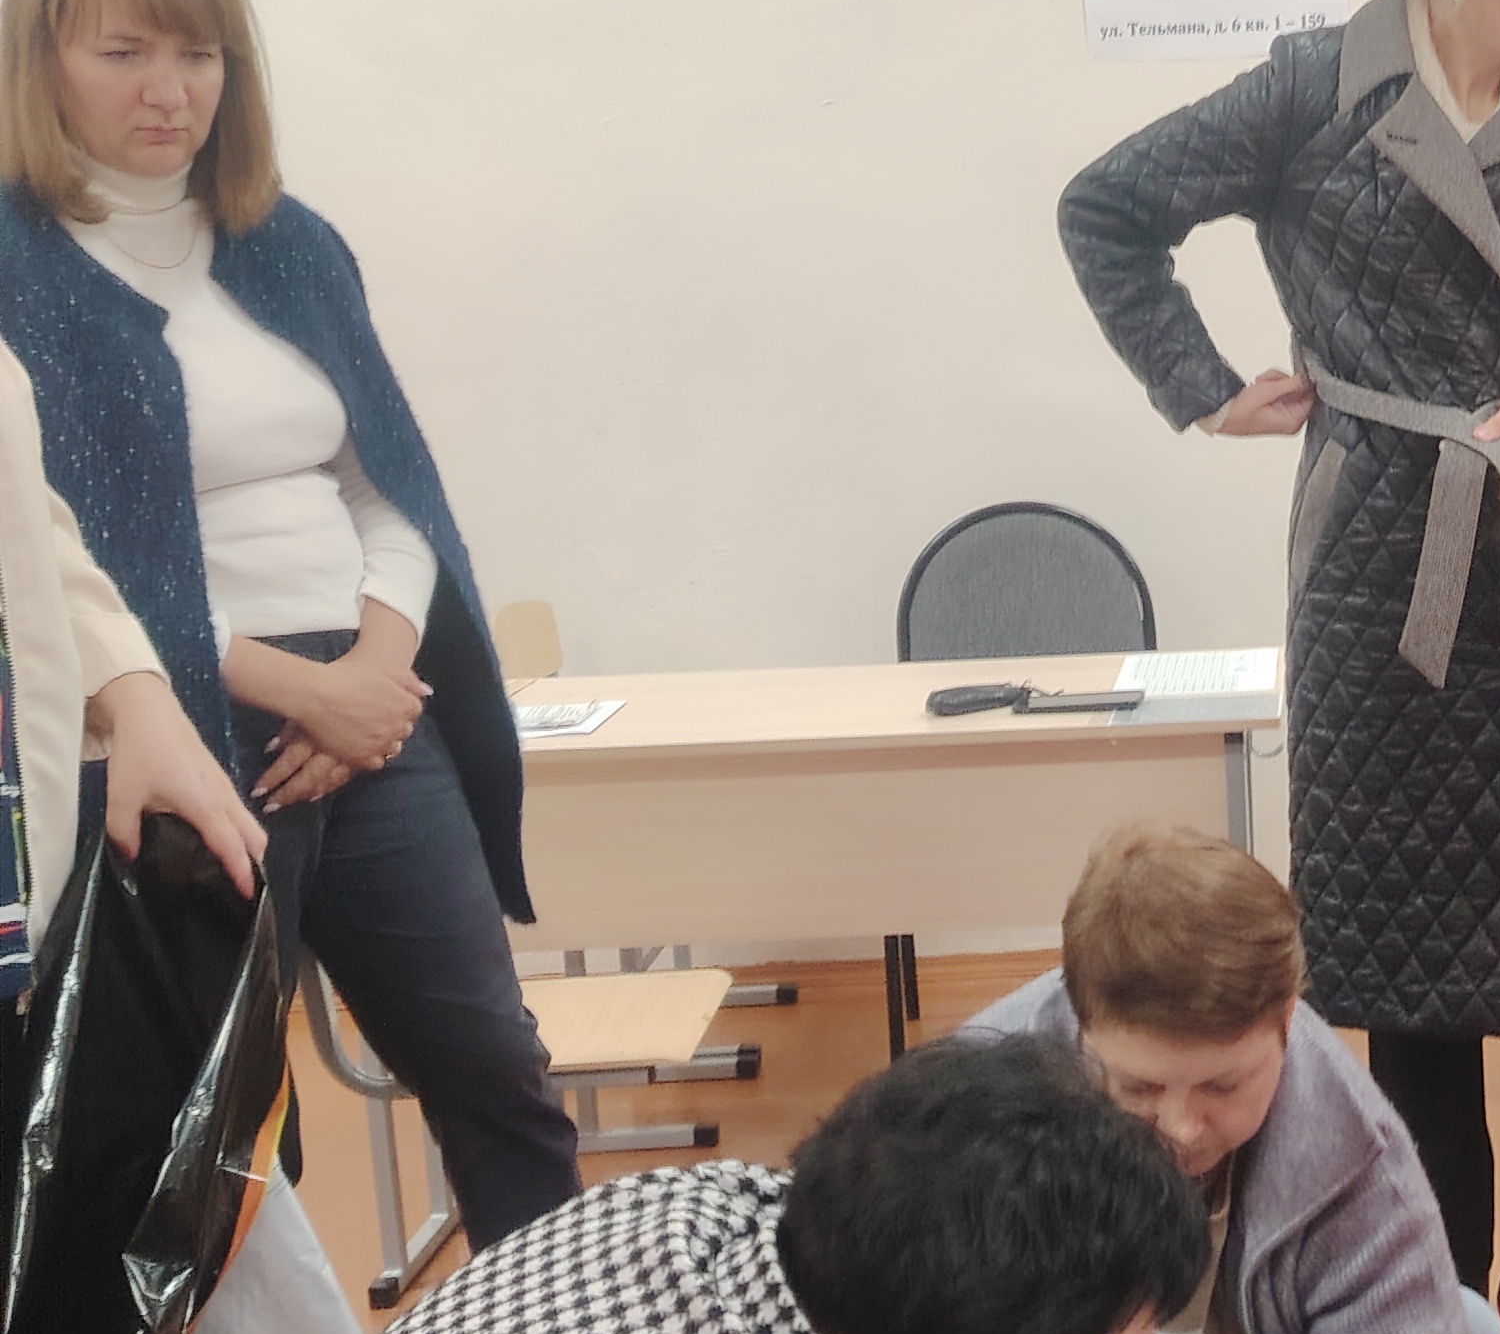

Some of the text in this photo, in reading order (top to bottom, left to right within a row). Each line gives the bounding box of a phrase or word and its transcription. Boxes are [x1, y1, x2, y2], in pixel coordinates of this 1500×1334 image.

[1100, 25, 1122, 41] ул.
[1127, 20, 1210, 38] Тельмана,
[1232, 17, 1241, 34] 6
